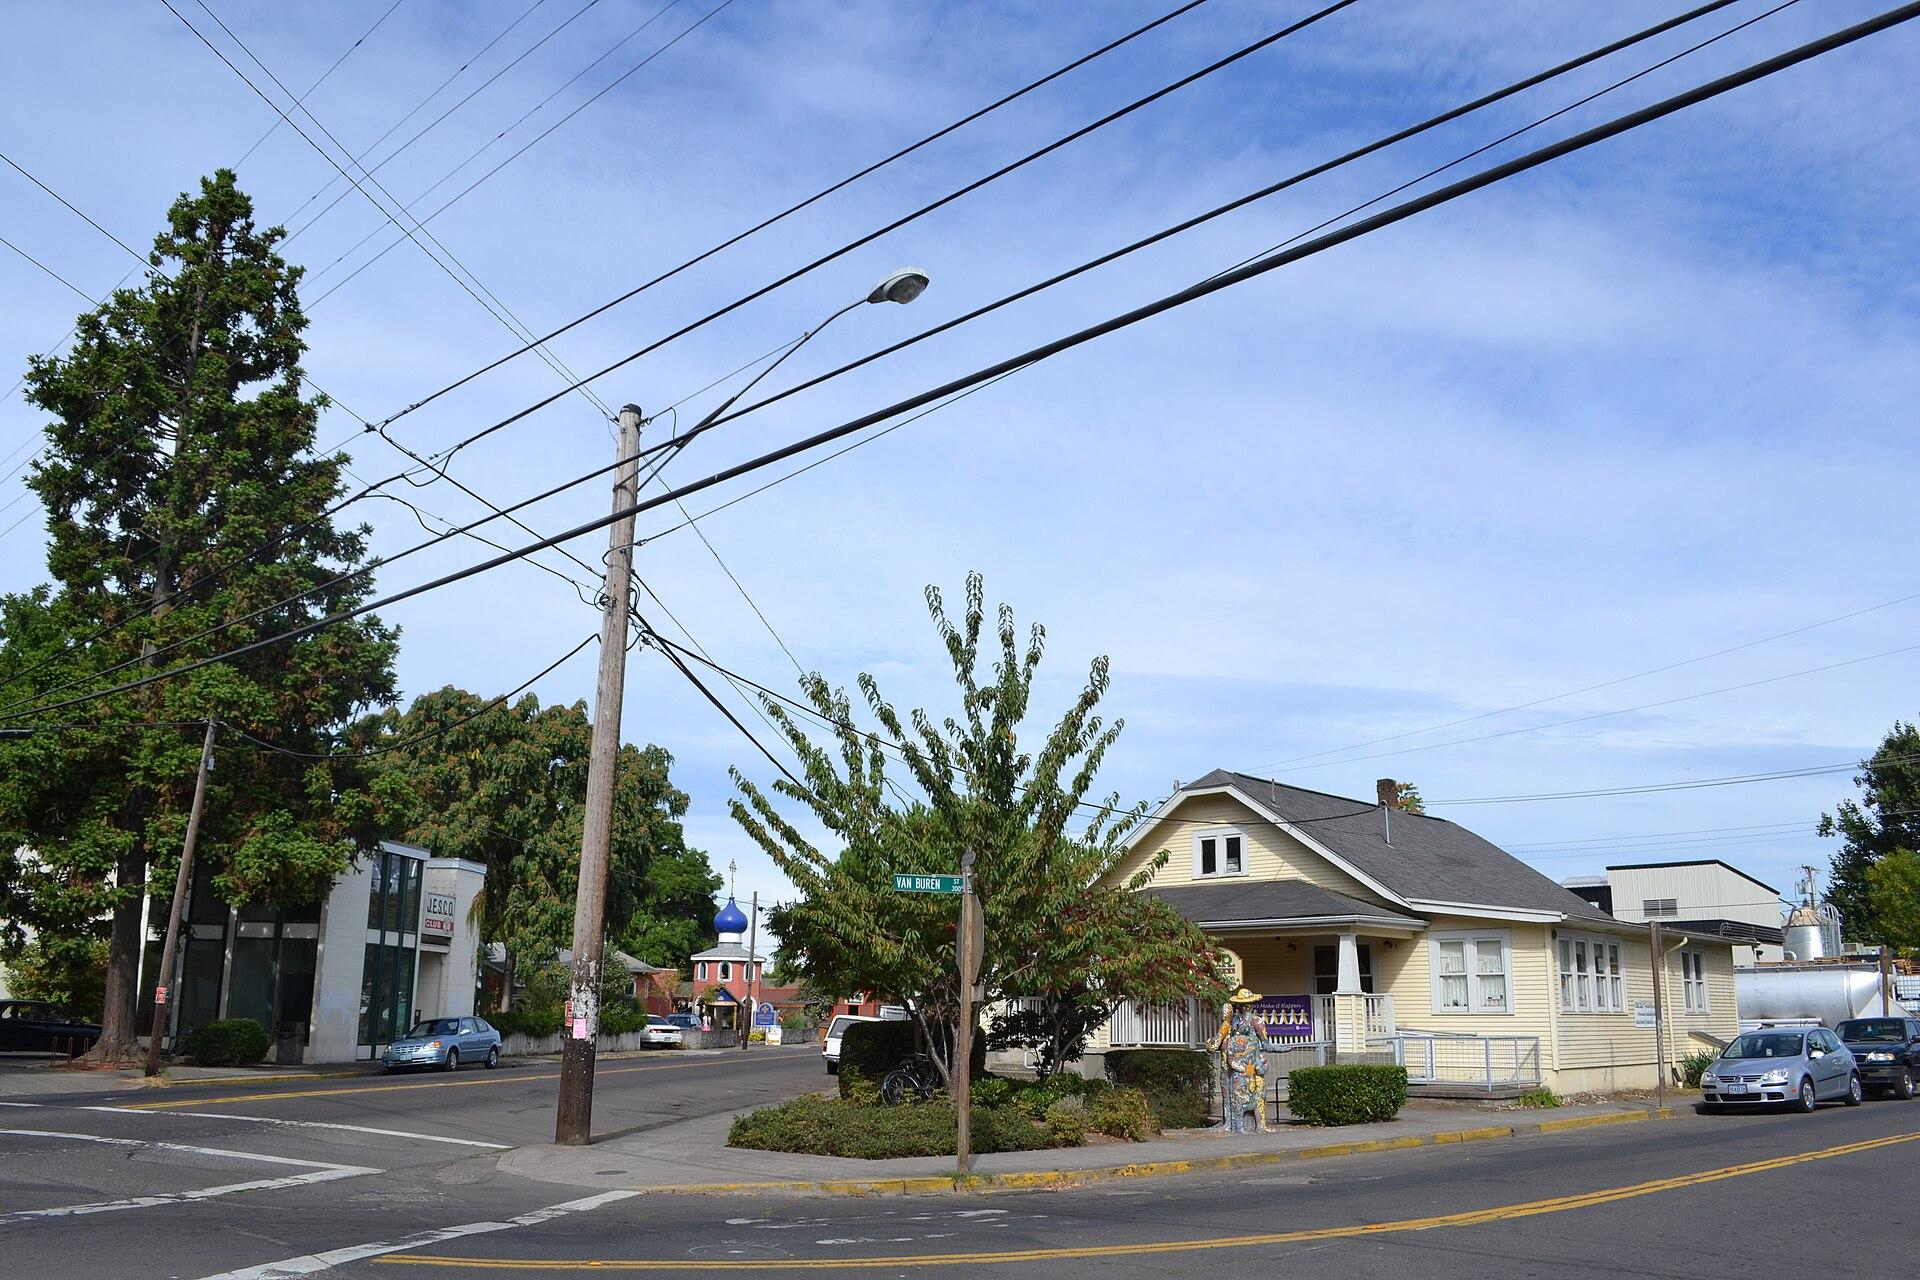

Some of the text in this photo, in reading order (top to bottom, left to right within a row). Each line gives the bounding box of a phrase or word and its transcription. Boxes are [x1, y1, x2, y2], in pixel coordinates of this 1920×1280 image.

[896, 877, 940, 889] VAN BUREN
[425, 919, 442, 929] CLUB
